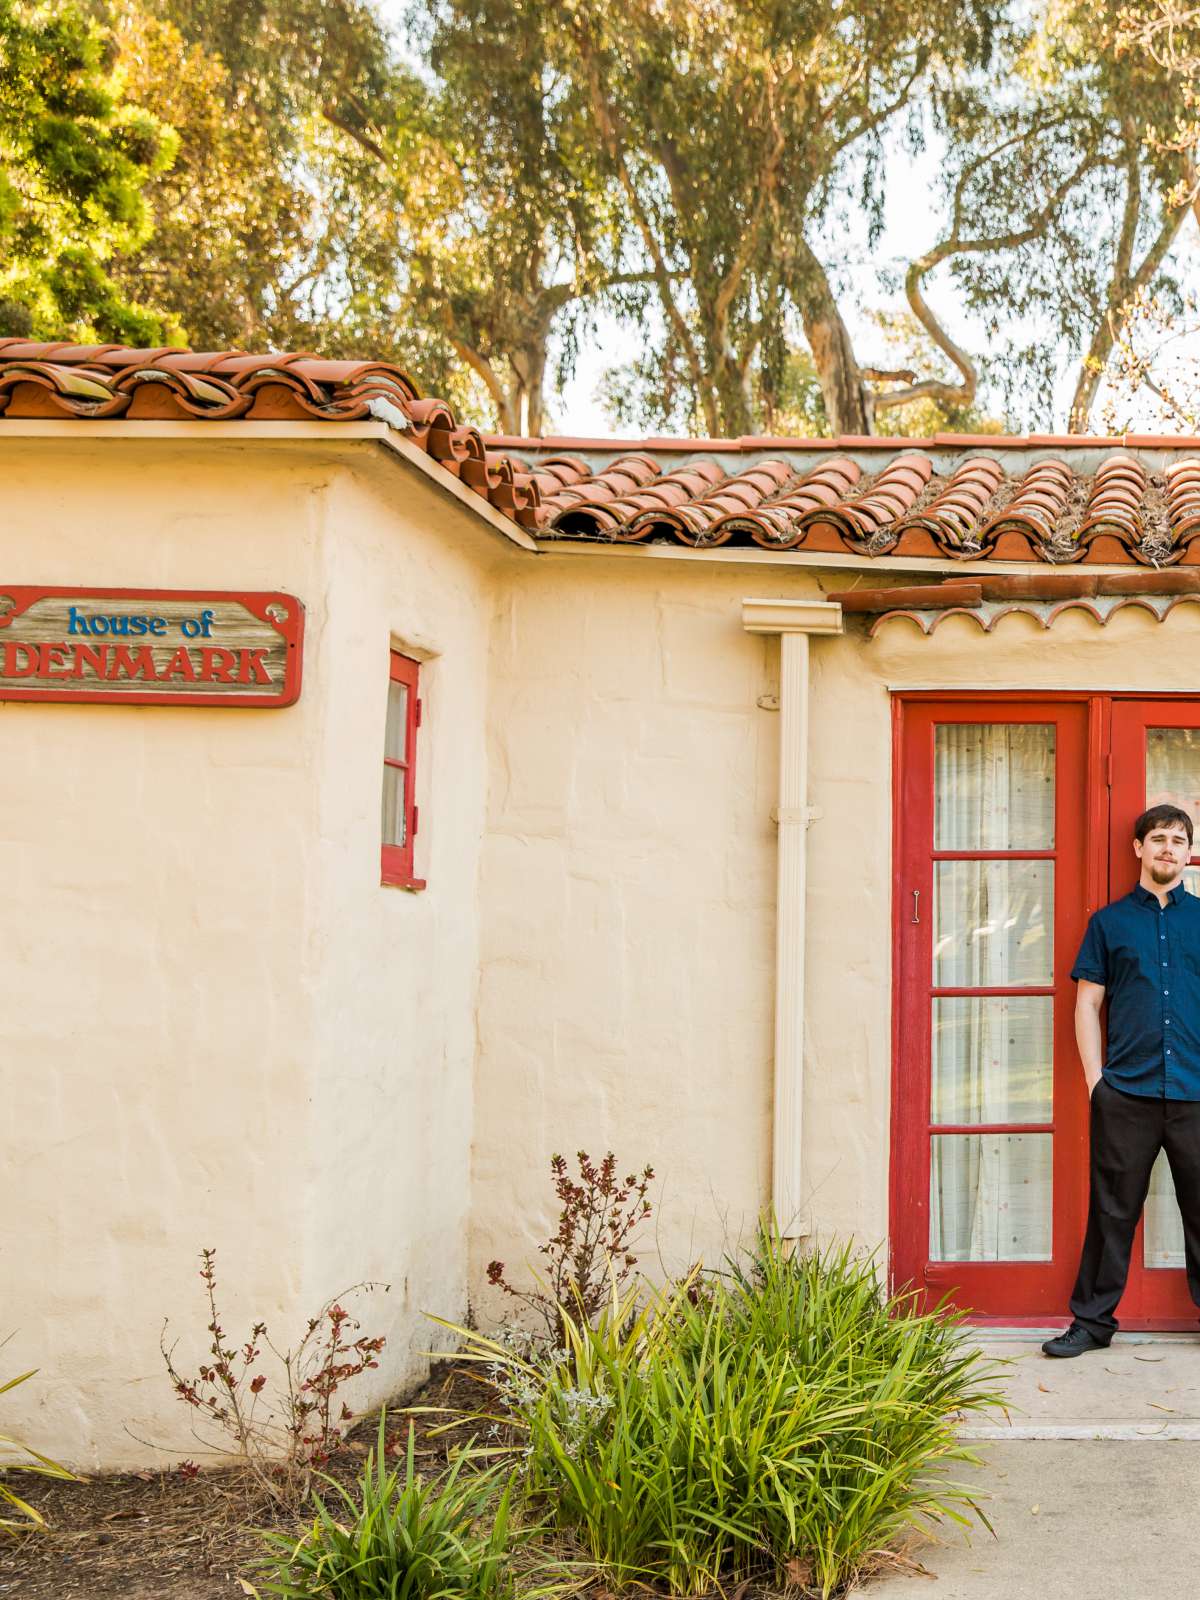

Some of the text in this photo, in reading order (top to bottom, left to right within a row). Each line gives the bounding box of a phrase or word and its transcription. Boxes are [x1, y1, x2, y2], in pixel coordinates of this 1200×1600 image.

[68, 607, 216, 638] house of
[1, 641, 273, 684] DENMARK
